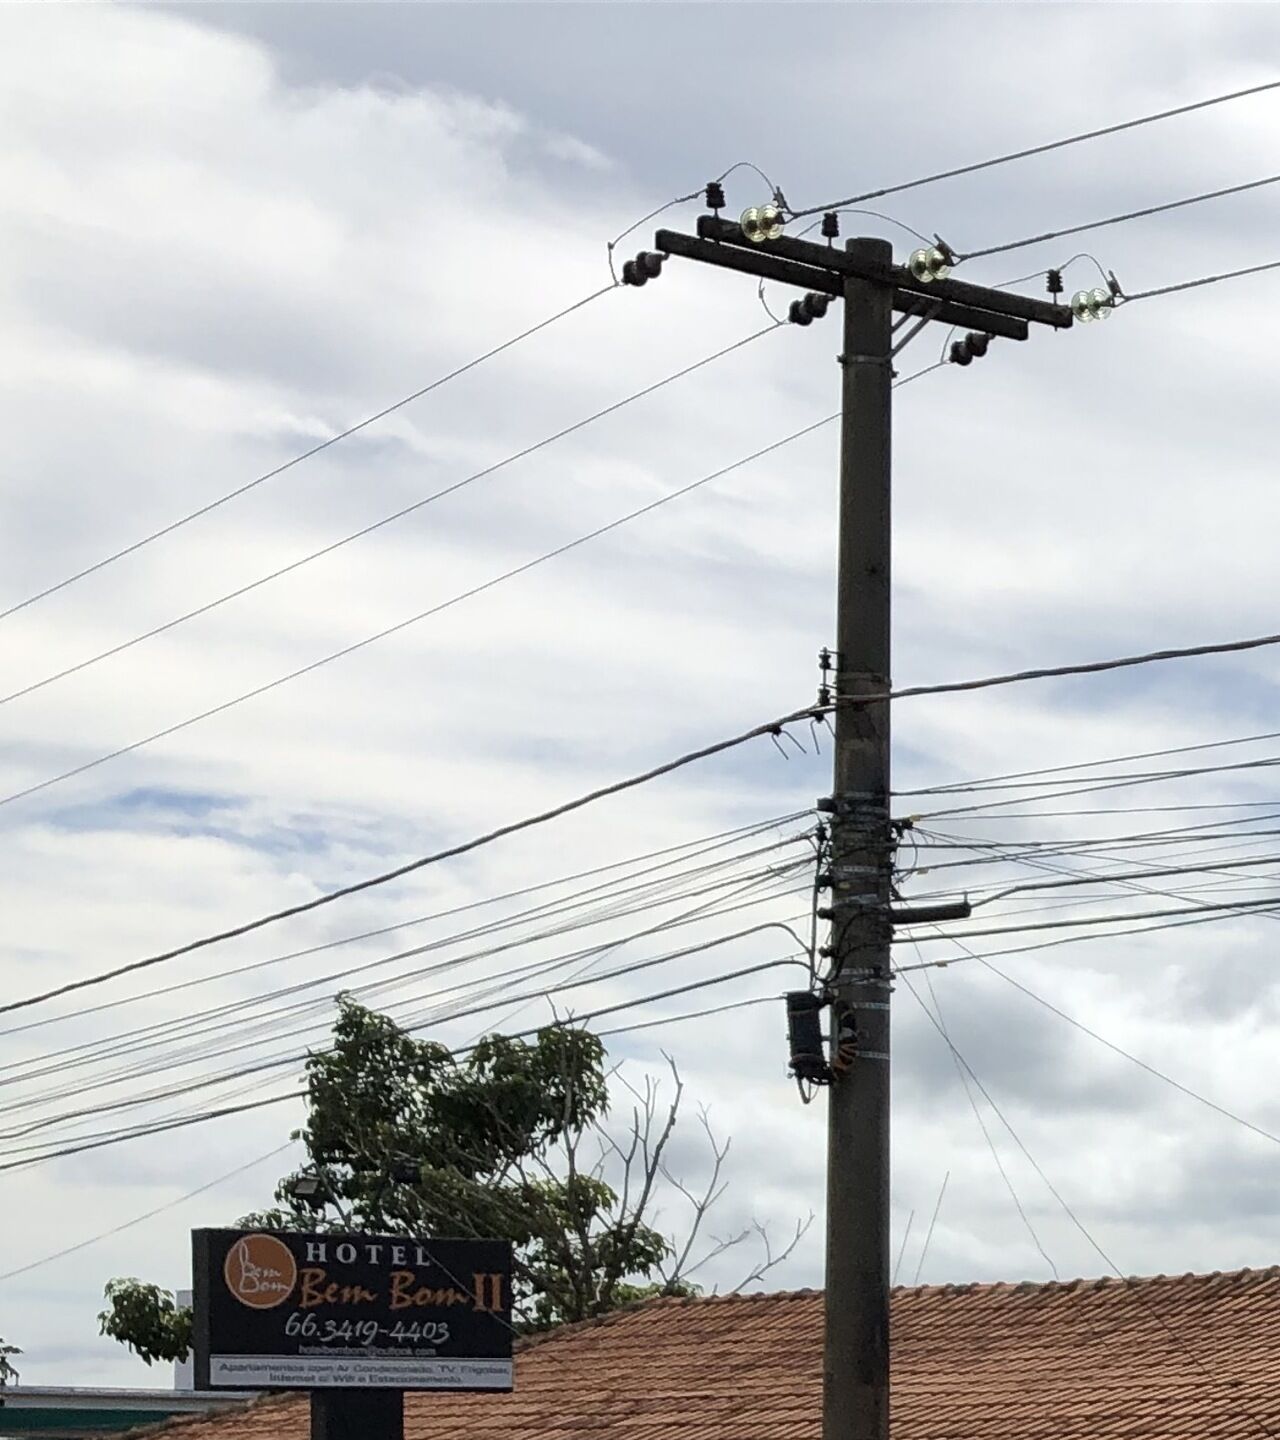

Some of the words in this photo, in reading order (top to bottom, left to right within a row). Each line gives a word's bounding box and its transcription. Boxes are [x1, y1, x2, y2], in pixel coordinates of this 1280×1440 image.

[306, 1242, 431, 1266] HOTEL
[300, 1267, 379, 1309] Bem
[389, 1270, 468, 1310] Bom
[472, 1272, 504, 1312] II
[284, 1311, 450, 1345] 66.3419-4403
